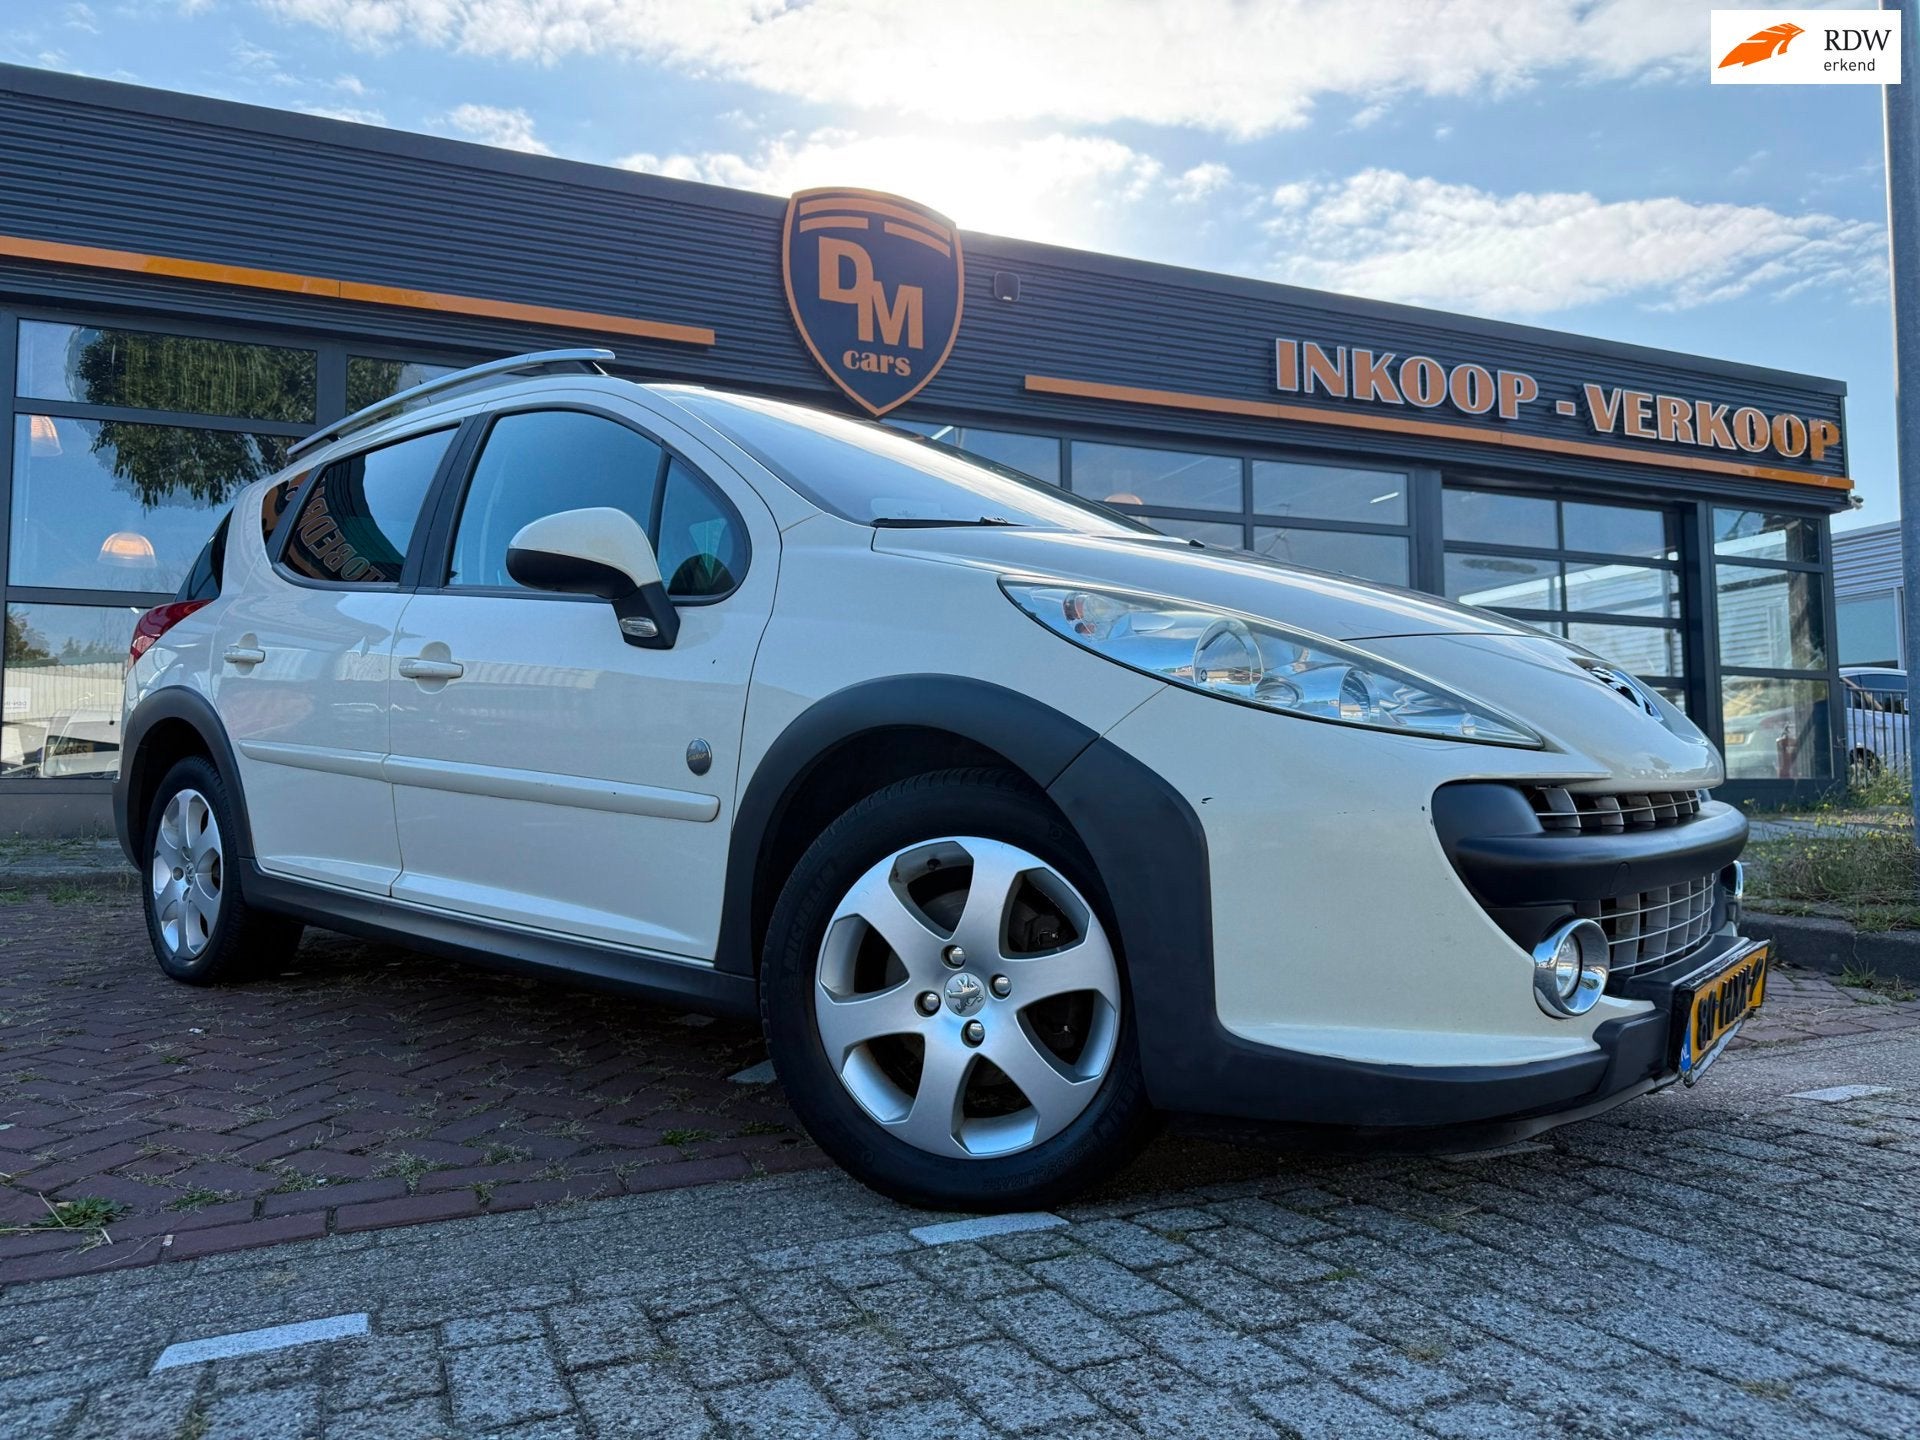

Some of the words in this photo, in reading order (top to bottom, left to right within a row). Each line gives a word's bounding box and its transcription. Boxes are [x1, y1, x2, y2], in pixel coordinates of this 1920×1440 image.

[818, 235, 924, 350] DM
[842, 350, 911, 377] cars
[1275, 338, 1539, 419] INKOOP
[1583, 383, 1840, 461] VERKOOP
